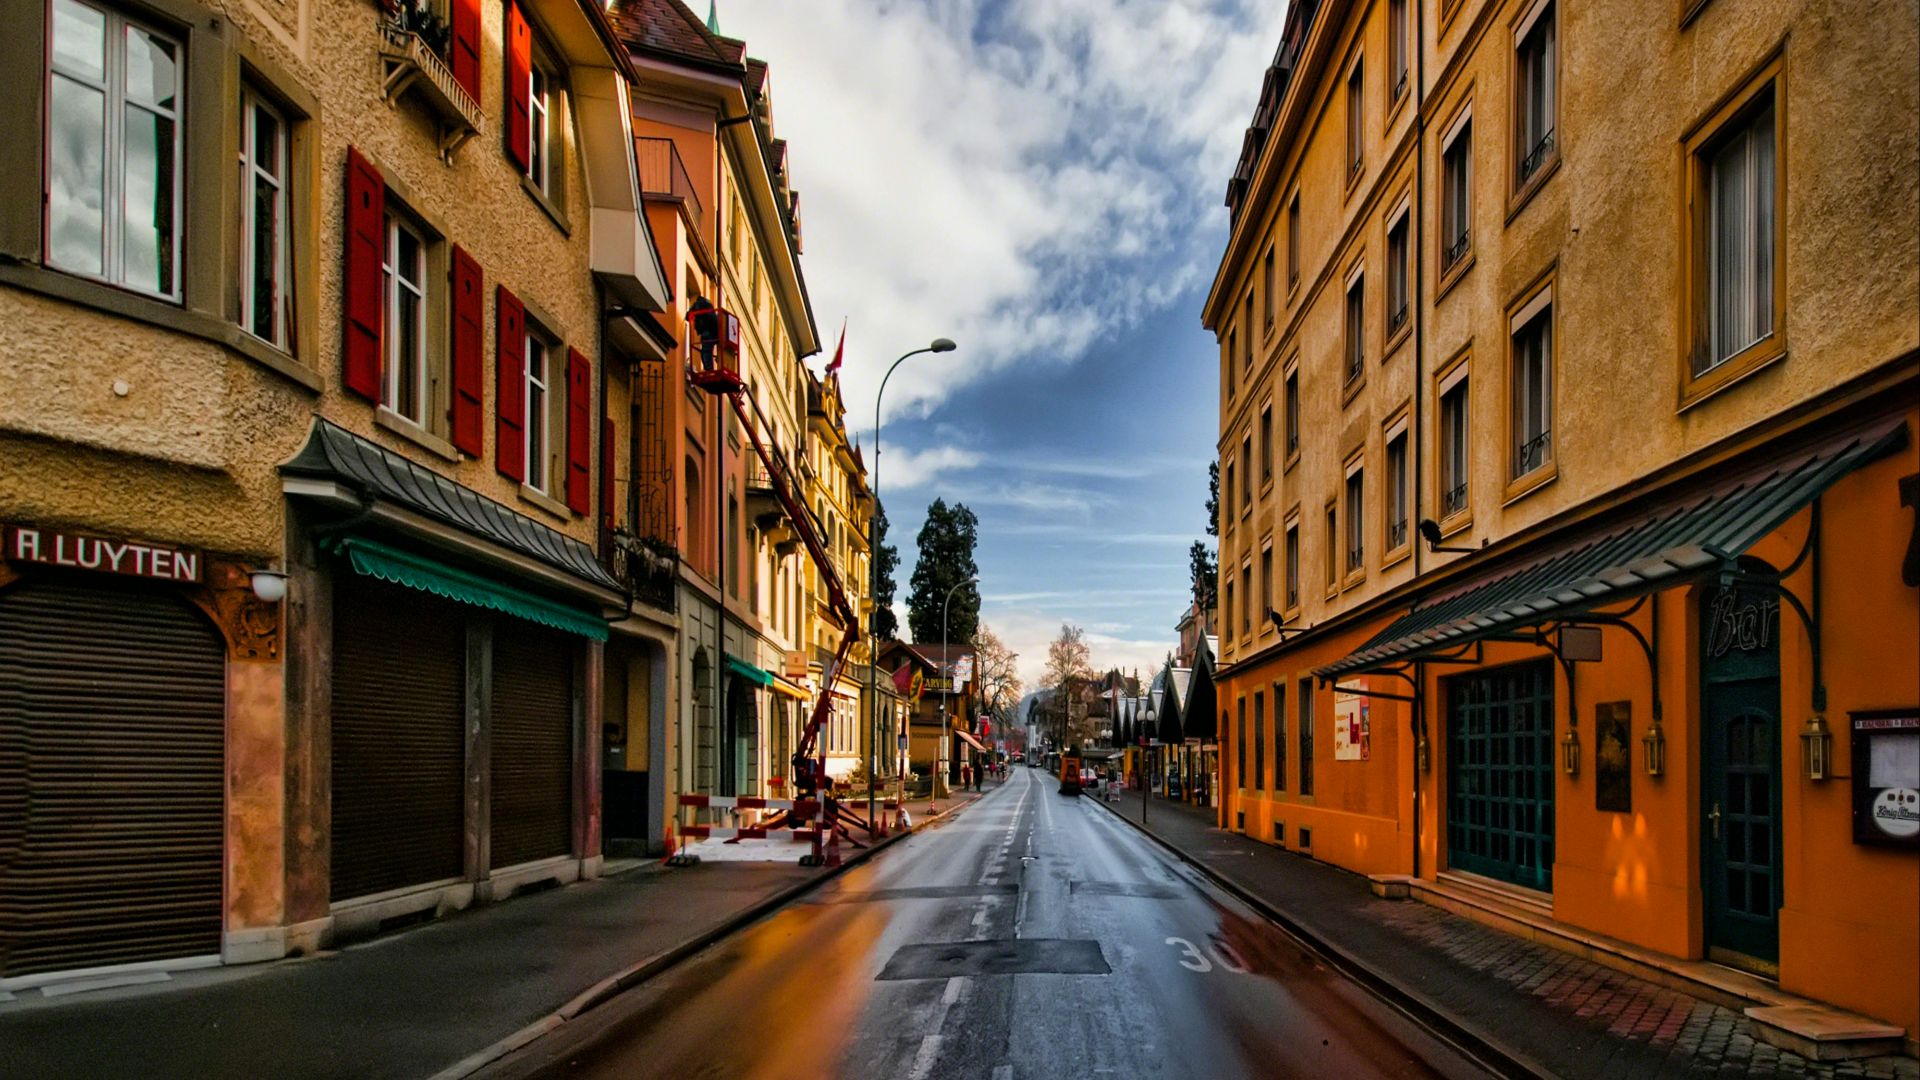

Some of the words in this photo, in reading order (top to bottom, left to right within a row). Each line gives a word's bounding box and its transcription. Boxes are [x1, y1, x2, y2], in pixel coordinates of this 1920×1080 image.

[16, 528, 47, 562] A.
[55, 534, 196, 581] LUYTEN
[1706, 588, 1779, 657] Bar
[924, 677, 953, 689] ARVING
[1164, 936, 1250, 974] 30
